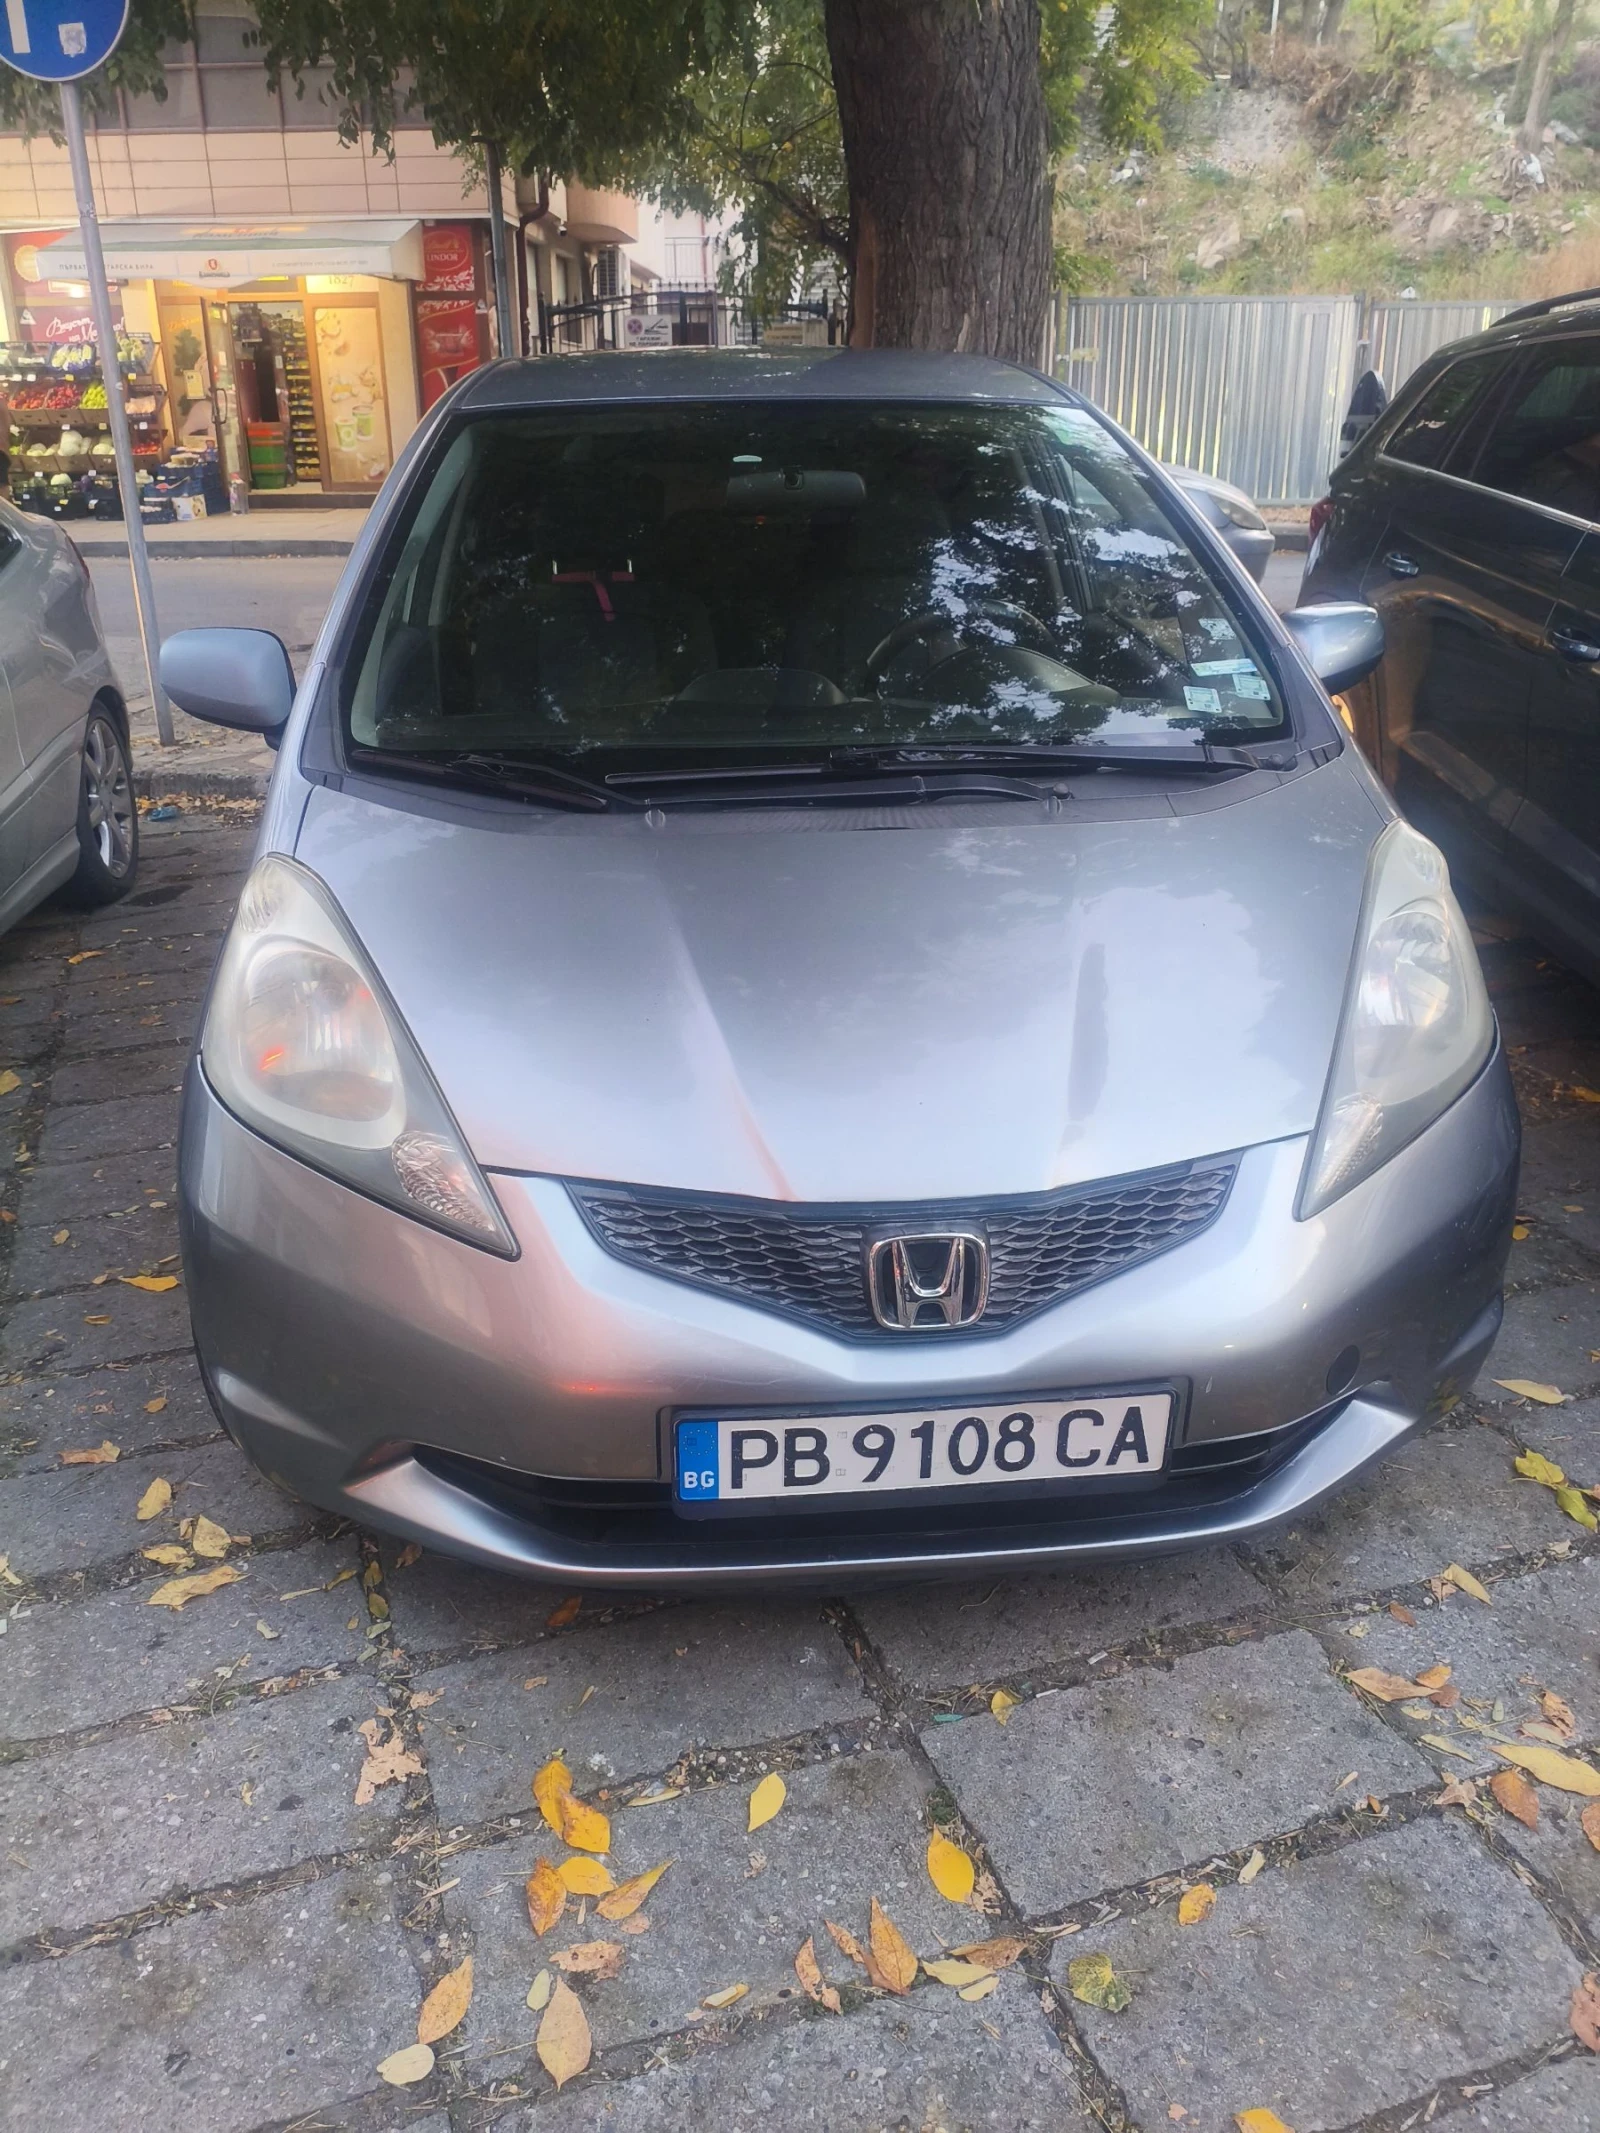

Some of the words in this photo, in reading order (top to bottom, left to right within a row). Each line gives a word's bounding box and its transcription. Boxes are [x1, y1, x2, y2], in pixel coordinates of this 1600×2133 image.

[731, 1427, 831, 1490] PB
[852, 1411, 1036, 1484] 9108
[1056, 1405, 1149, 1468] CA
[683, 1470, 716, 1489] BG
